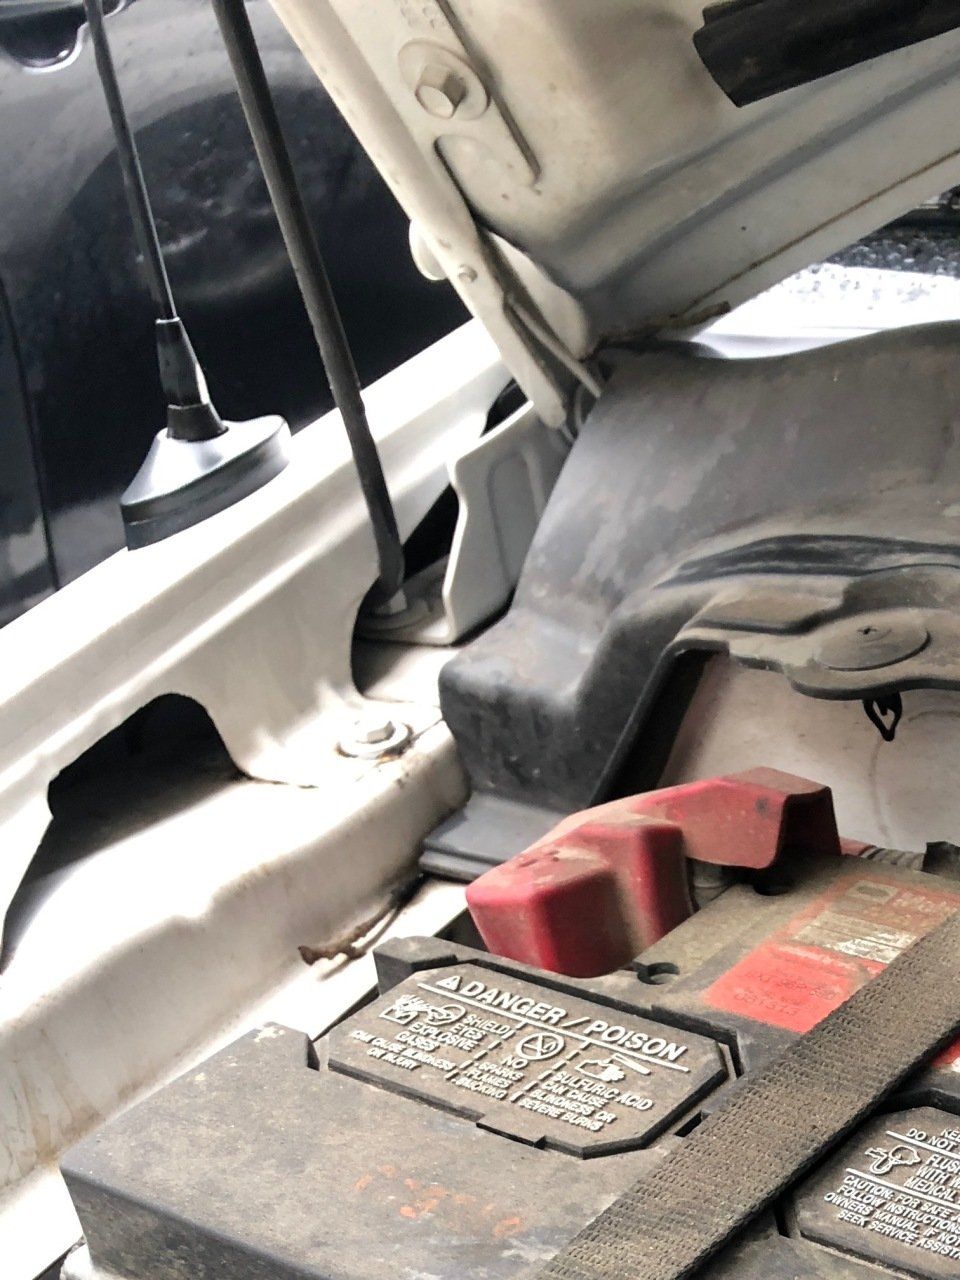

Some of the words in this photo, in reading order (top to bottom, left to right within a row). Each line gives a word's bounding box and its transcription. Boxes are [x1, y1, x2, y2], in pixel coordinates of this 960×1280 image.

[451, 1023, 487, 1040] EYES
[462, 981, 568, 1025] DANGER
[585, 1020, 688, 1061] POISON
[464, 1014, 511, 1035] SHIELD
[396, 1031, 440, 1052] GASES
[410, 1022, 479, 1052] EXPLOSIVE
[372, 1037, 407, 1054] CAUSE
[403, 1049, 457, 1071] BLINDNESS
[502, 1055, 529, 1070] NO
[542, 1080, 568, 1096] CAN
[568, 1089, 609, 1108] CAUSE
[553, 1071, 620, 1099] SULFURIC
[617, 1090, 653, 1111] ACID
[519, 1098, 563, 1118] SEVERE
[561, 1111, 604, 1131] BURNS
[530, 1089, 596, 1116] BLINDNESS
[595, 1110, 617, 1124] OR
[907, 1128, 927, 1141] DO
[929, 1135, 957, 1151] NOT
[917, 1165, 951, 1183] WITH
[837, 1184, 886, 1208] FOLLOW
[904, 1176, 958, 1201] MEDICAL
[825, 1192, 875, 1216] OWNERS
[924, 1227, 940, 1237] IF
[895, 1194, 921, 1209] FOR
[922, 1202, 953, 1218] SAFE
[839, 1209, 868, 1227] SEEK
[869, 1221, 919, 1243] SERVICE
